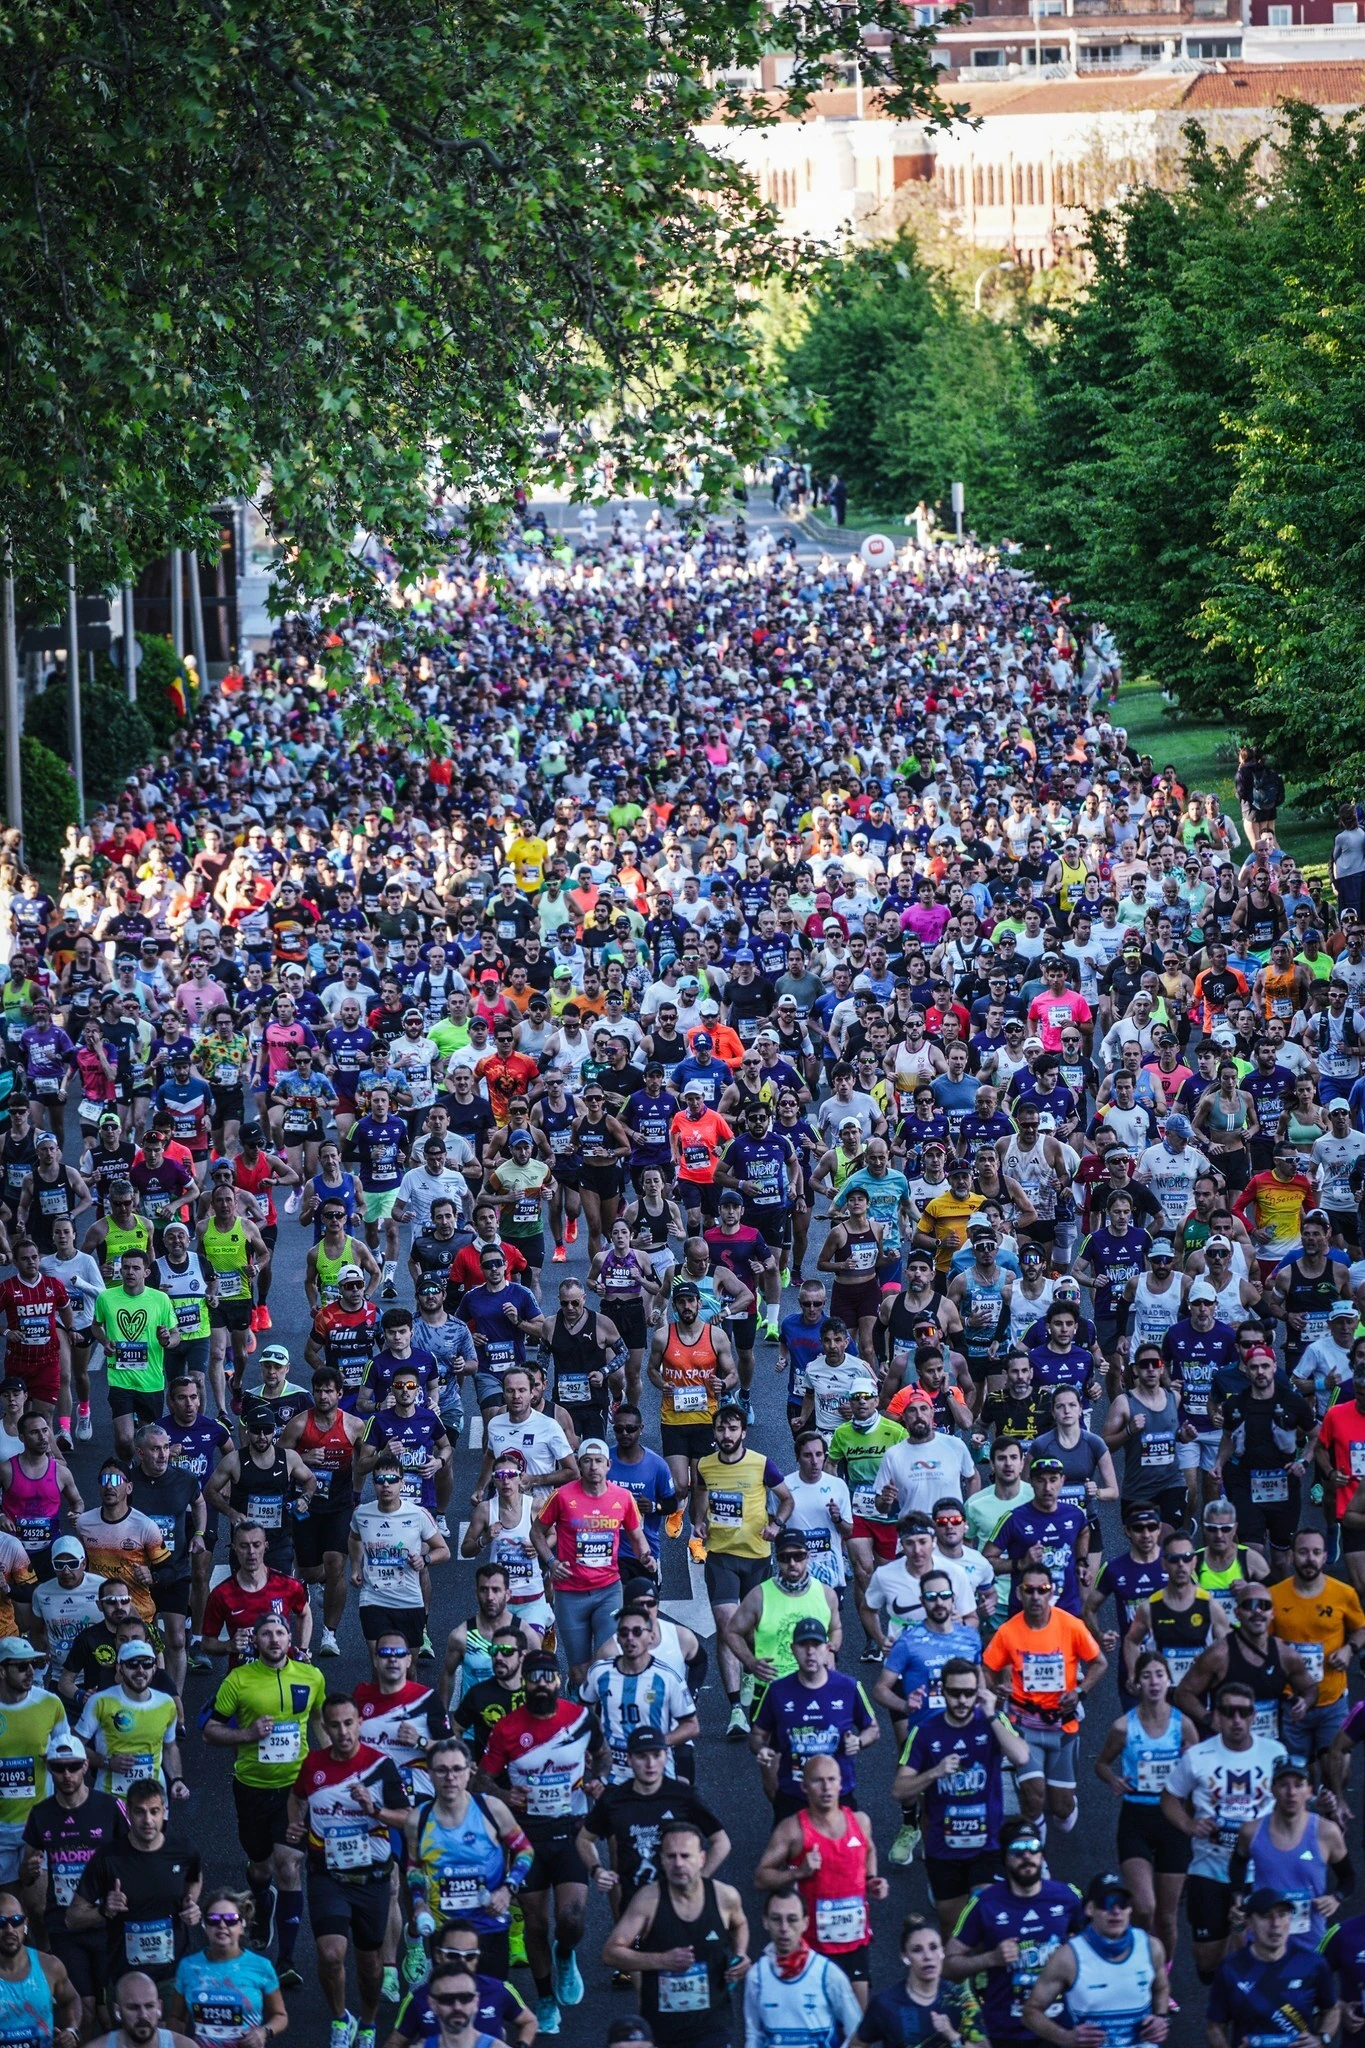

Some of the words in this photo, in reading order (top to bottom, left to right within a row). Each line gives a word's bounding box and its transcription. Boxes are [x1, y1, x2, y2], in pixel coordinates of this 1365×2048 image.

[17, 1303, 53, 1316] REWE
[123, 1351, 141, 1359] 24111
[258, 1507, 274, 1515] 1983
[715, 1503, 735, 1512] 23792
[570, 1518, 619, 1529] MADRID
[23, 1529, 44, 1537] 24528
[584, 1544, 606, 1553] 23699
[378, 1568, 395, 1578] 1944
[618, 1703, 640, 1724] 10
[270, 1737, 290, 1746] 3256
[5, 1759, 28, 1767] ZURICH
[0, 1771, 26, 1782] 21693
[336, 1840, 358, 1851] 2852
[50, 1849, 96, 1863] MADRI
[449, 1880, 477, 1892] 23495
[143, 1922, 166, 1930] ZURICH
[209, 1994, 235, 2002] ZURICH
